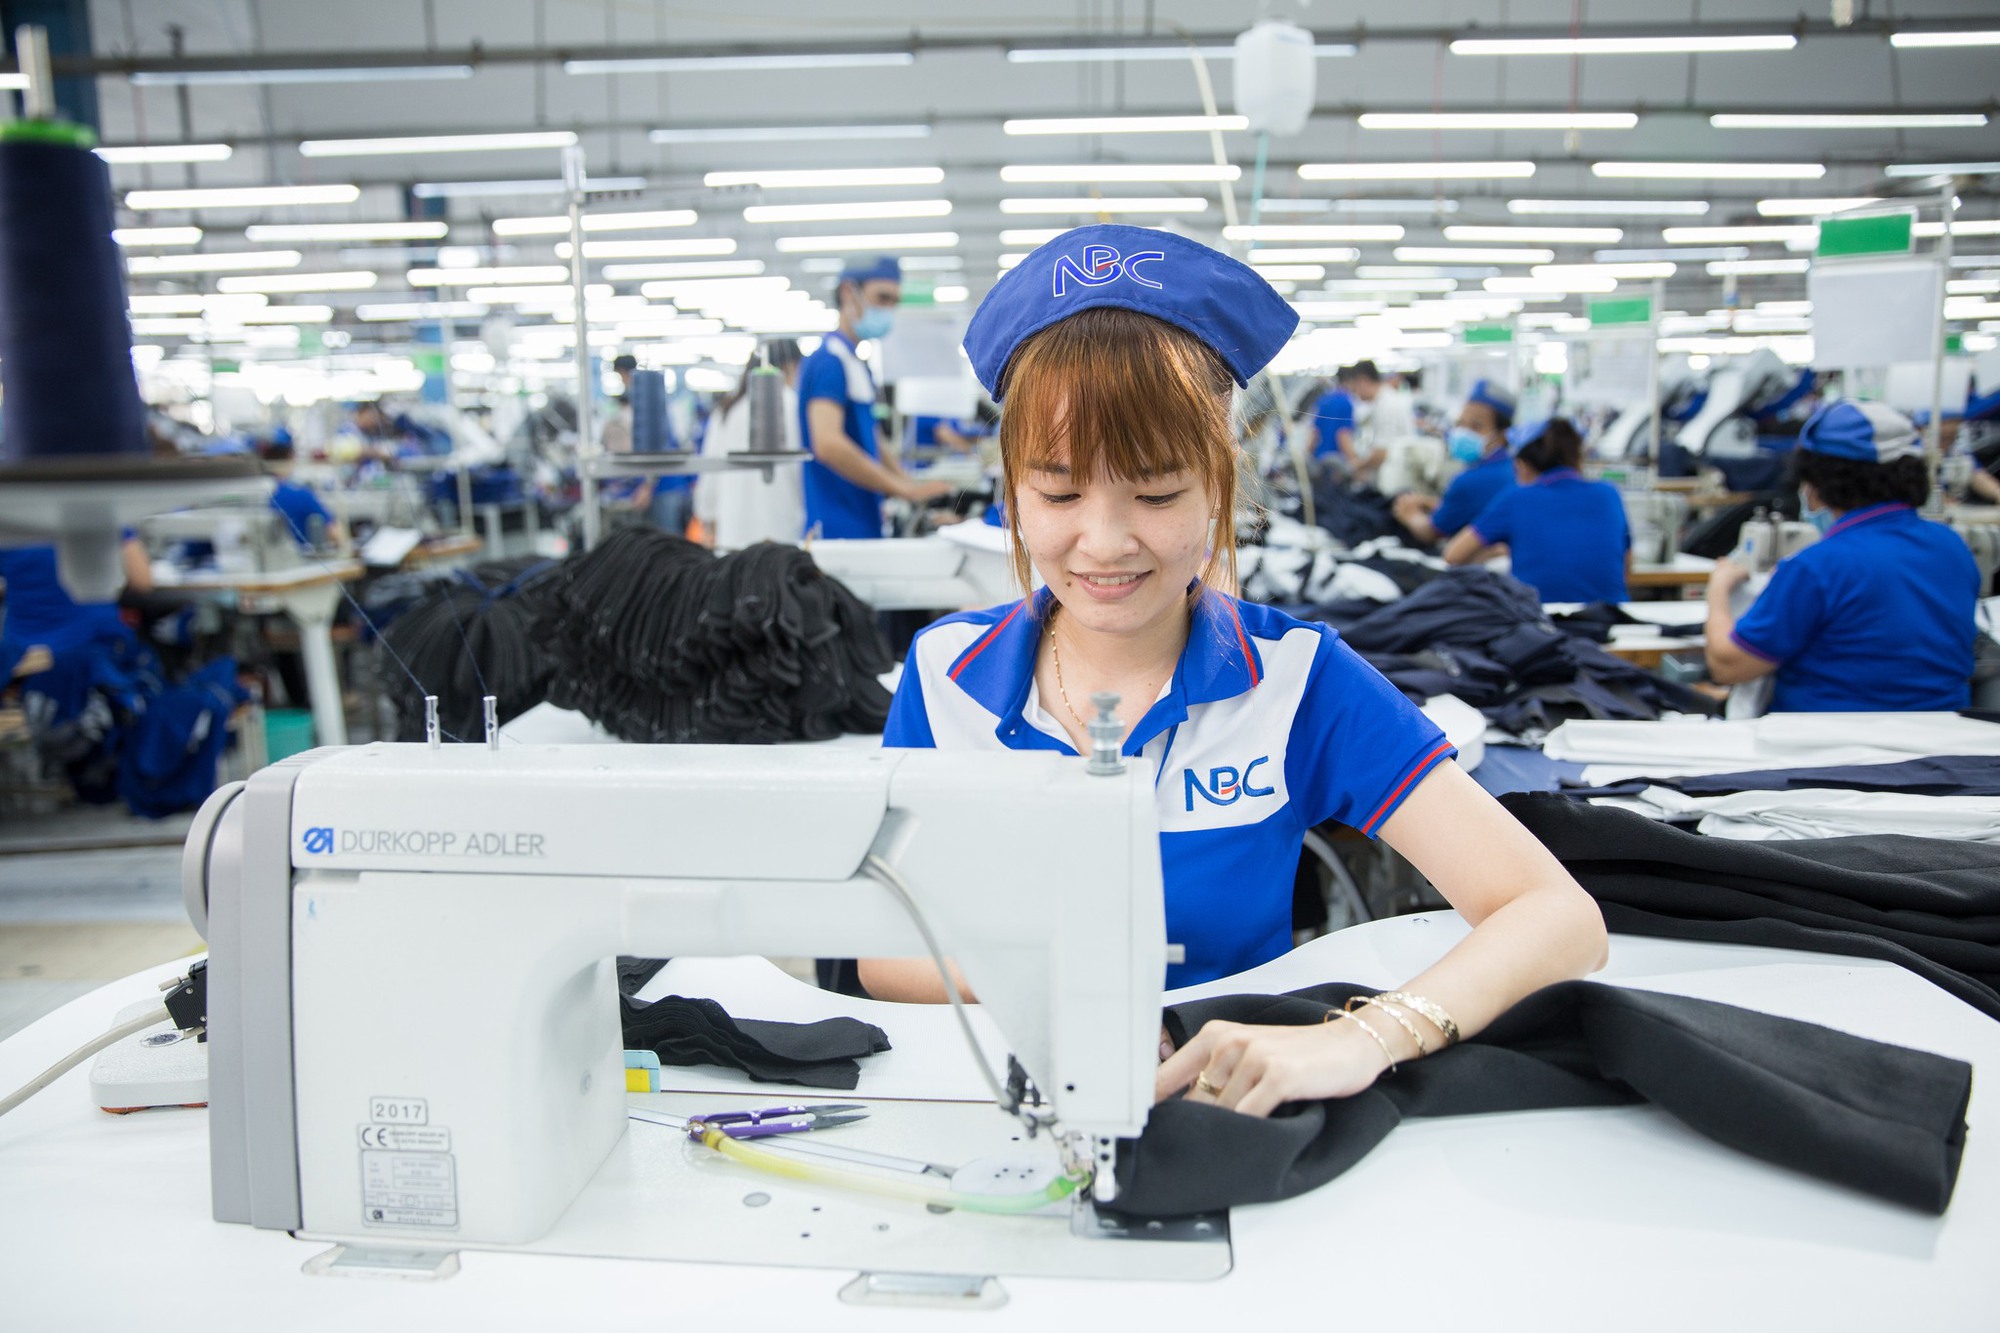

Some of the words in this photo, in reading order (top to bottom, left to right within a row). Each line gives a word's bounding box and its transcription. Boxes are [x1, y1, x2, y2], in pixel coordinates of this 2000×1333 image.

[1053, 244, 1165, 297] NBC
[1184, 755, 1275, 811] NBC
[464, 832, 545, 856] ADLER
[375, 1103, 422, 1119] 2017
[361, 1127, 388, 1147] CE
